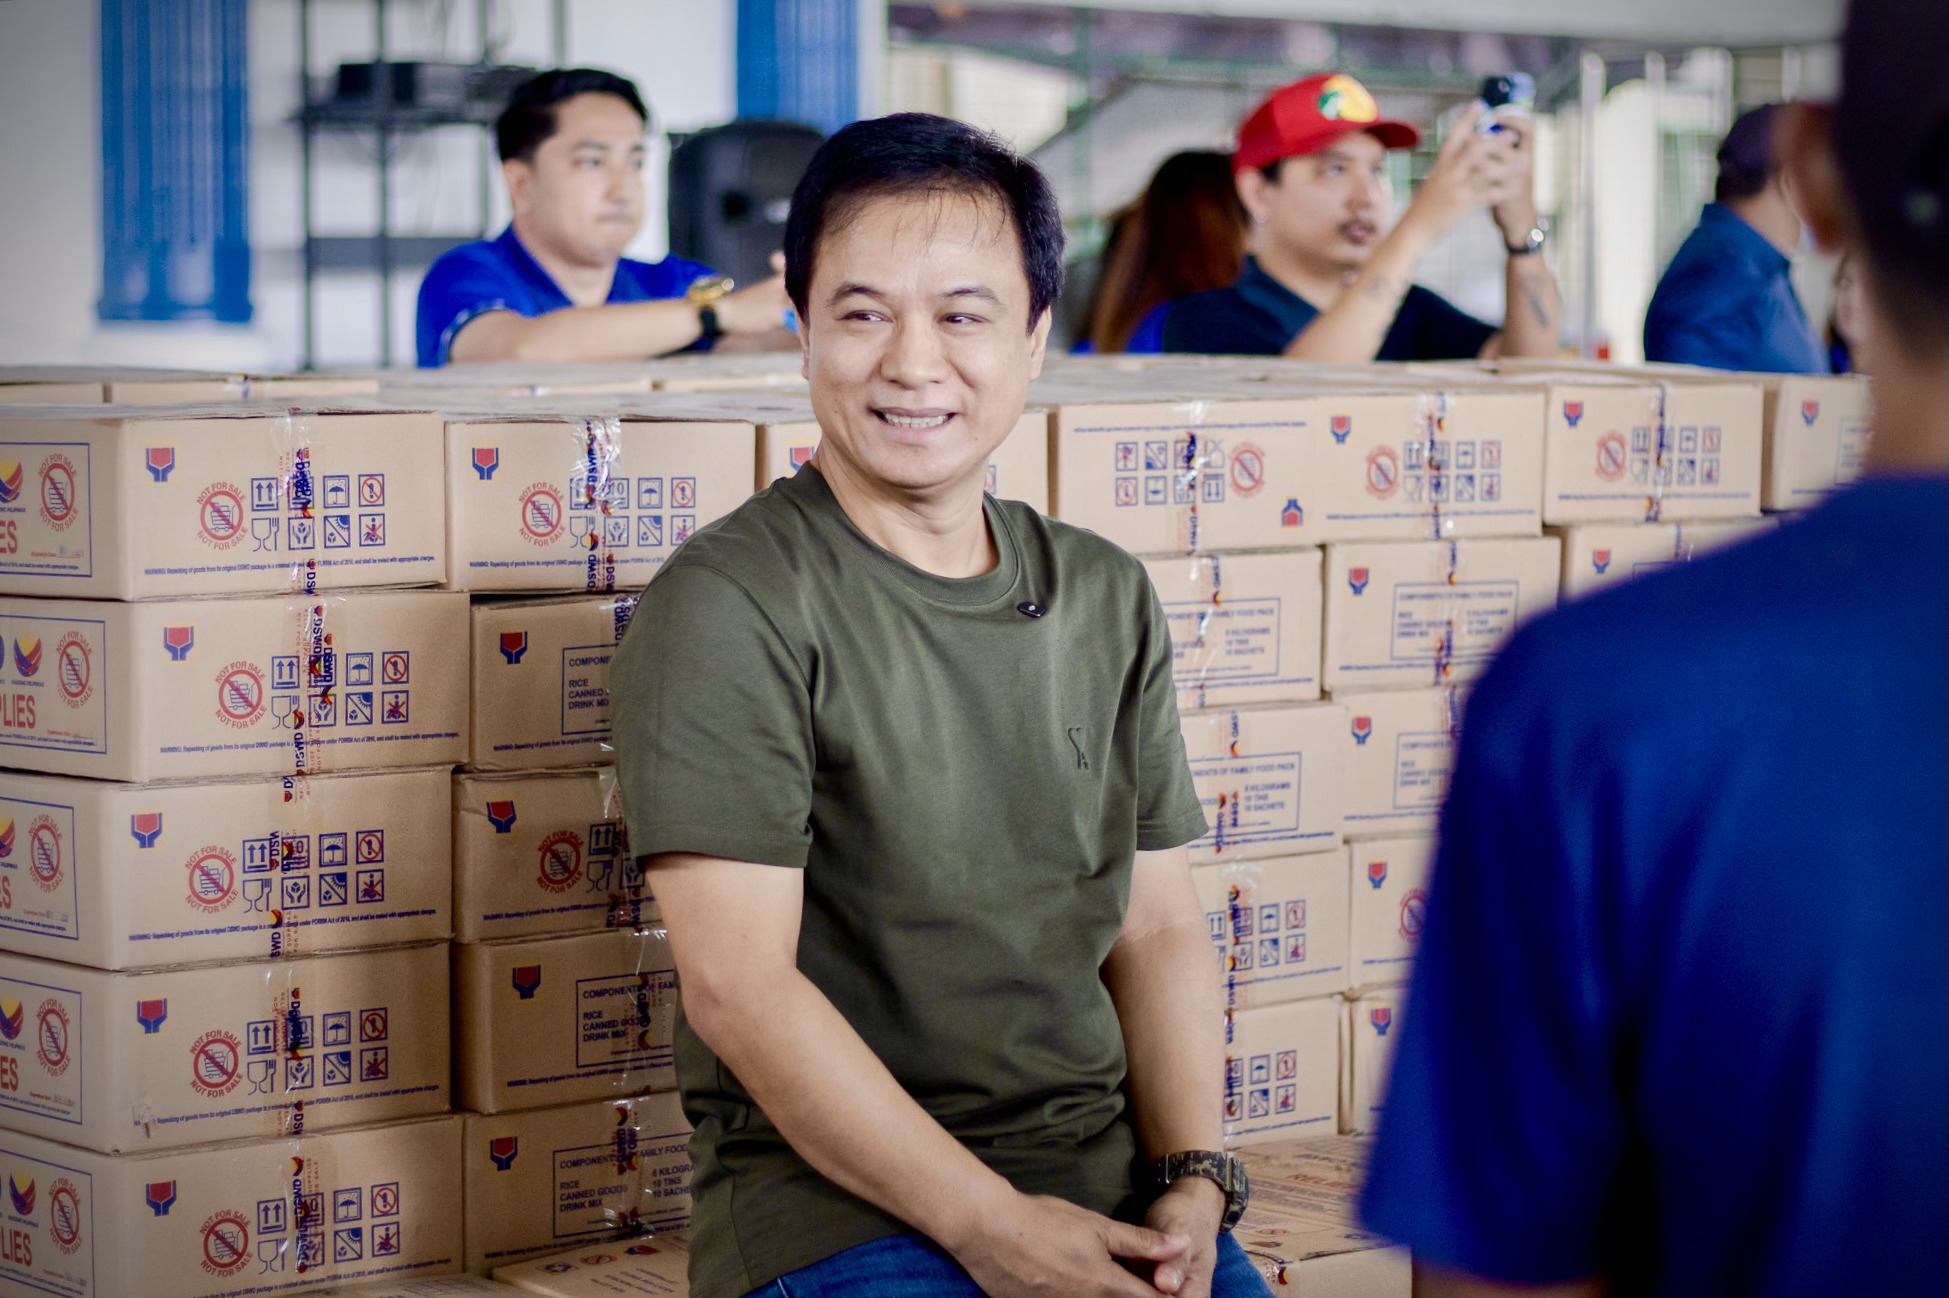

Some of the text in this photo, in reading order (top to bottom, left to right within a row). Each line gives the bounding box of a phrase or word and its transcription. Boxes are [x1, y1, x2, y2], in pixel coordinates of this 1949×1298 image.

[38, 453, 78, 478] NOT FOR SALE
[196, 482, 246, 505] NOT FOR SALE
[518, 482, 565, 504] NOT FOR SALE
[38, 507, 79, 532] NOT FOR SALE
[196, 526, 248, 550] NOT FOR SALE
[518, 525, 566, 547] NOT FOR SALE
[56, 630, 93, 655] NOT FOR SALE
[214, 660, 266, 684] NOT FOR SALE
[568, 679, 588, 688] RICE
[568, 688, 604, 698] CANNED
[568, 699, 594, 710] DRINK
[215, 705, 268, 730] NOT FOR SALE
[538, 830, 584, 853] NOT FOR SALE
[185, 846, 238, 870] NOT FOR SALE
[536, 870, 583, 894] NOT FOR SALE
[185, 888, 240, 914] NOT FOR SALE
[46, 998, 58, 1008] FOR
[582, 1020, 619, 1032] CANNED
[583, 1010, 603, 1020] RICE
[189, 1029, 242, 1054] NOT FOR SALE
[583, 1032, 609, 1042] DRINK
[190, 1072, 244, 1098] NOT FOR SALE
[560, 1180, 580, 1190] RICE
[664, 1176, 682, 1186] TINS
[560, 1190, 596, 1201] CANNED
[560, 1202, 586, 1212] DRINK
[199, 1208, 252, 1235] NOT FOR SALE
[200, 1252, 254, 1278] NOT FOR SALE
